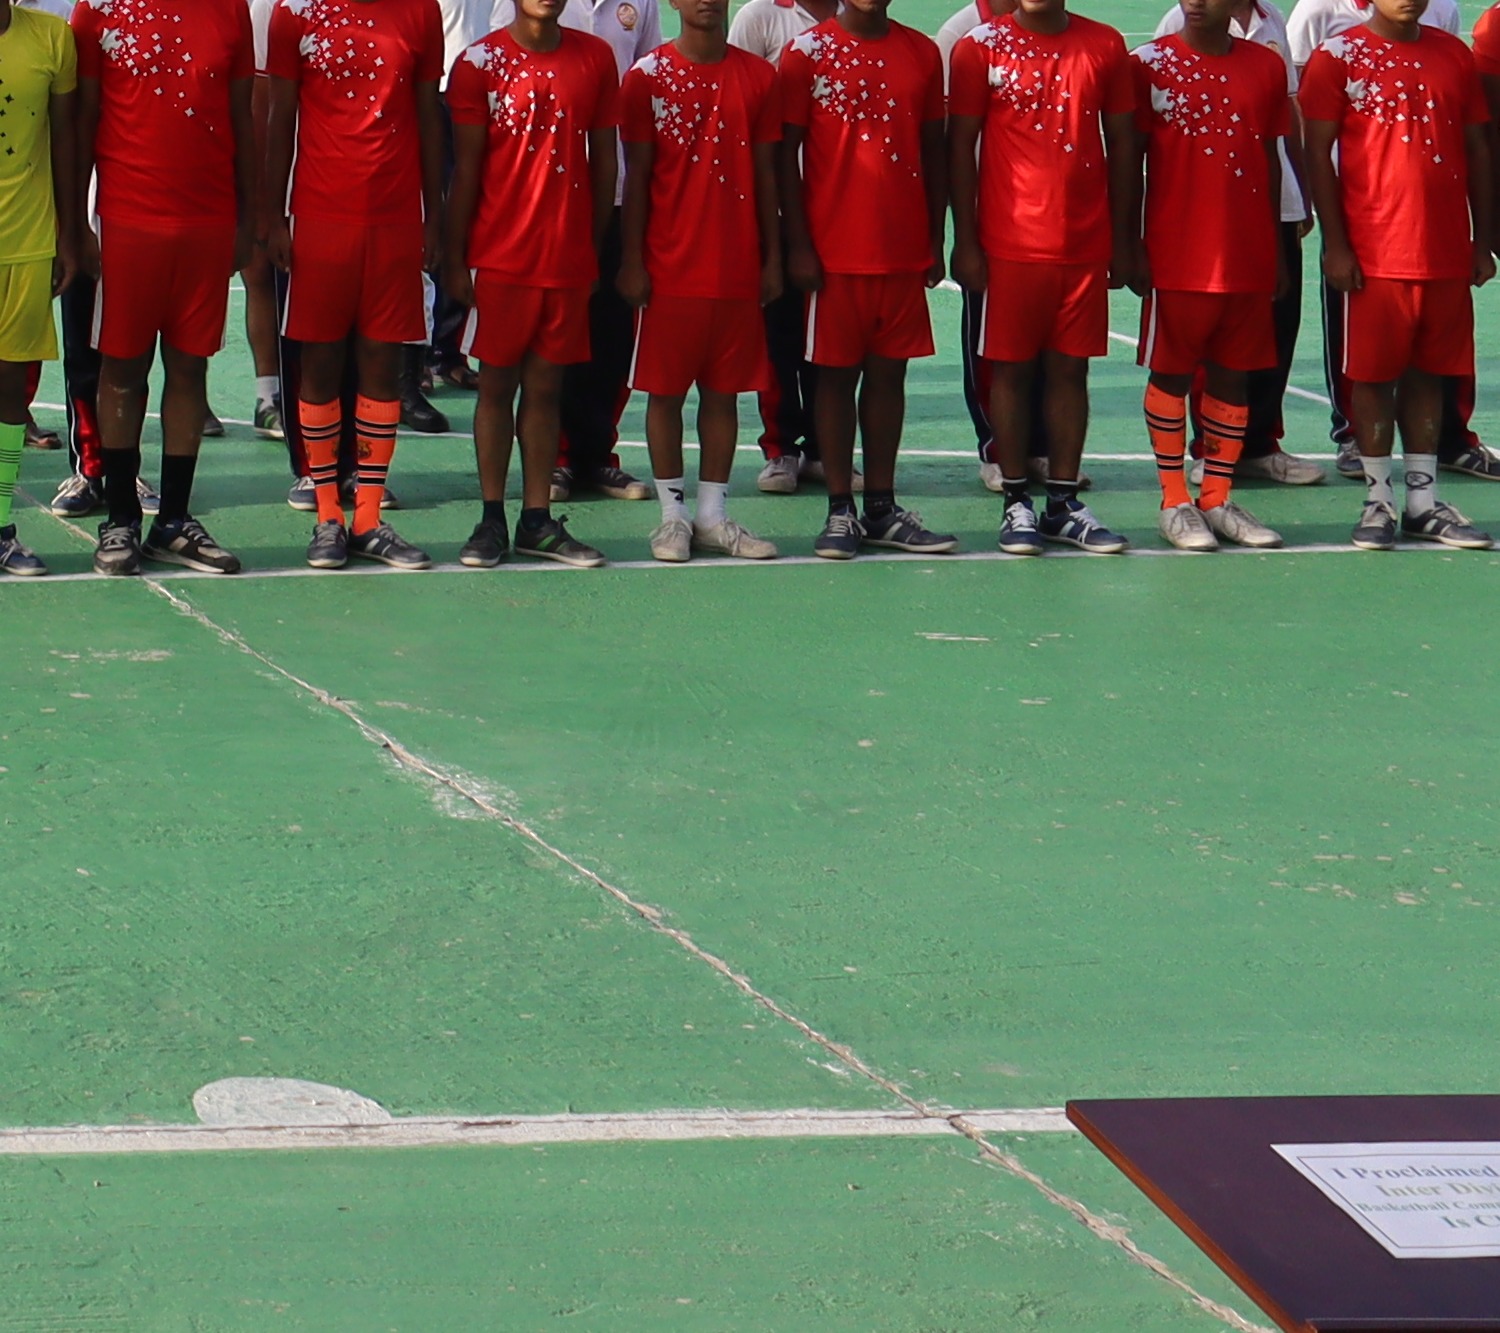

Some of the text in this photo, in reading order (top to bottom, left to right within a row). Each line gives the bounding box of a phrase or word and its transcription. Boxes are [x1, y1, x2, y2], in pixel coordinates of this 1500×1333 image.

[1332, 1165, 1499, 1180] I Proclaimed
[1375, 1184, 1442, 1198] Inter
[1356, 1201, 1450, 1212] Basketball
[1440, 1215, 1471, 1228] Is
